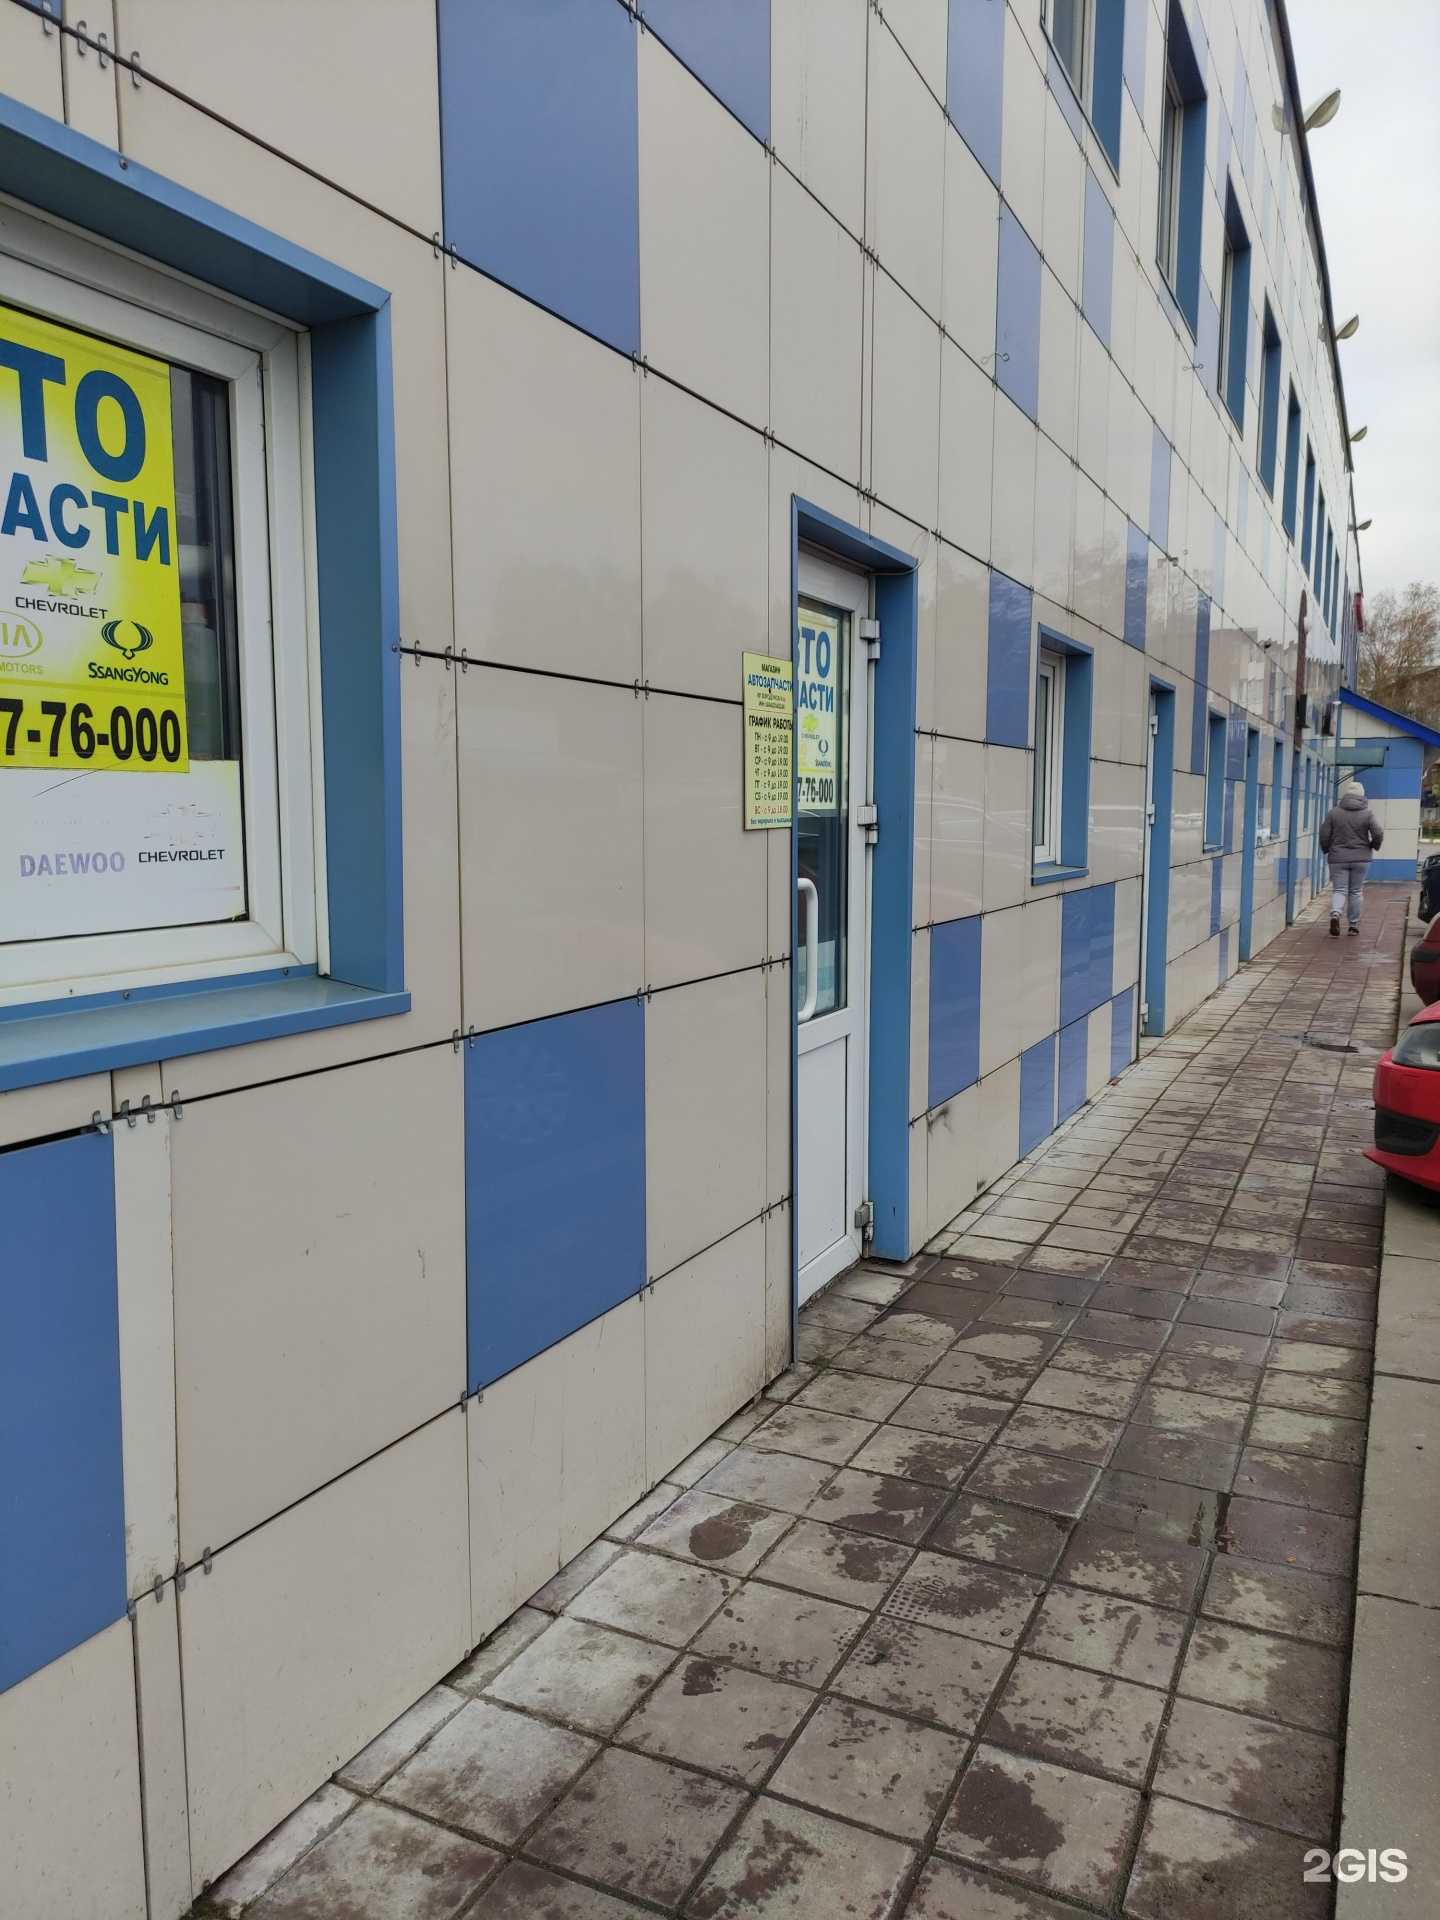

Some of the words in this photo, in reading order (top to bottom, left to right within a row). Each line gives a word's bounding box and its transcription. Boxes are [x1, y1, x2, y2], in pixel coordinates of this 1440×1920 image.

[1, 471, 170, 566] АСТИ
[16, 596, 108, 619] CHEVROLET
[798, 627, 831, 678] ТО
[749, 715, 771, 728] ГРАФИК
[20, 851, 125, 877] DAEWOO
[138, 849, 225, 862] CHEVROLET
